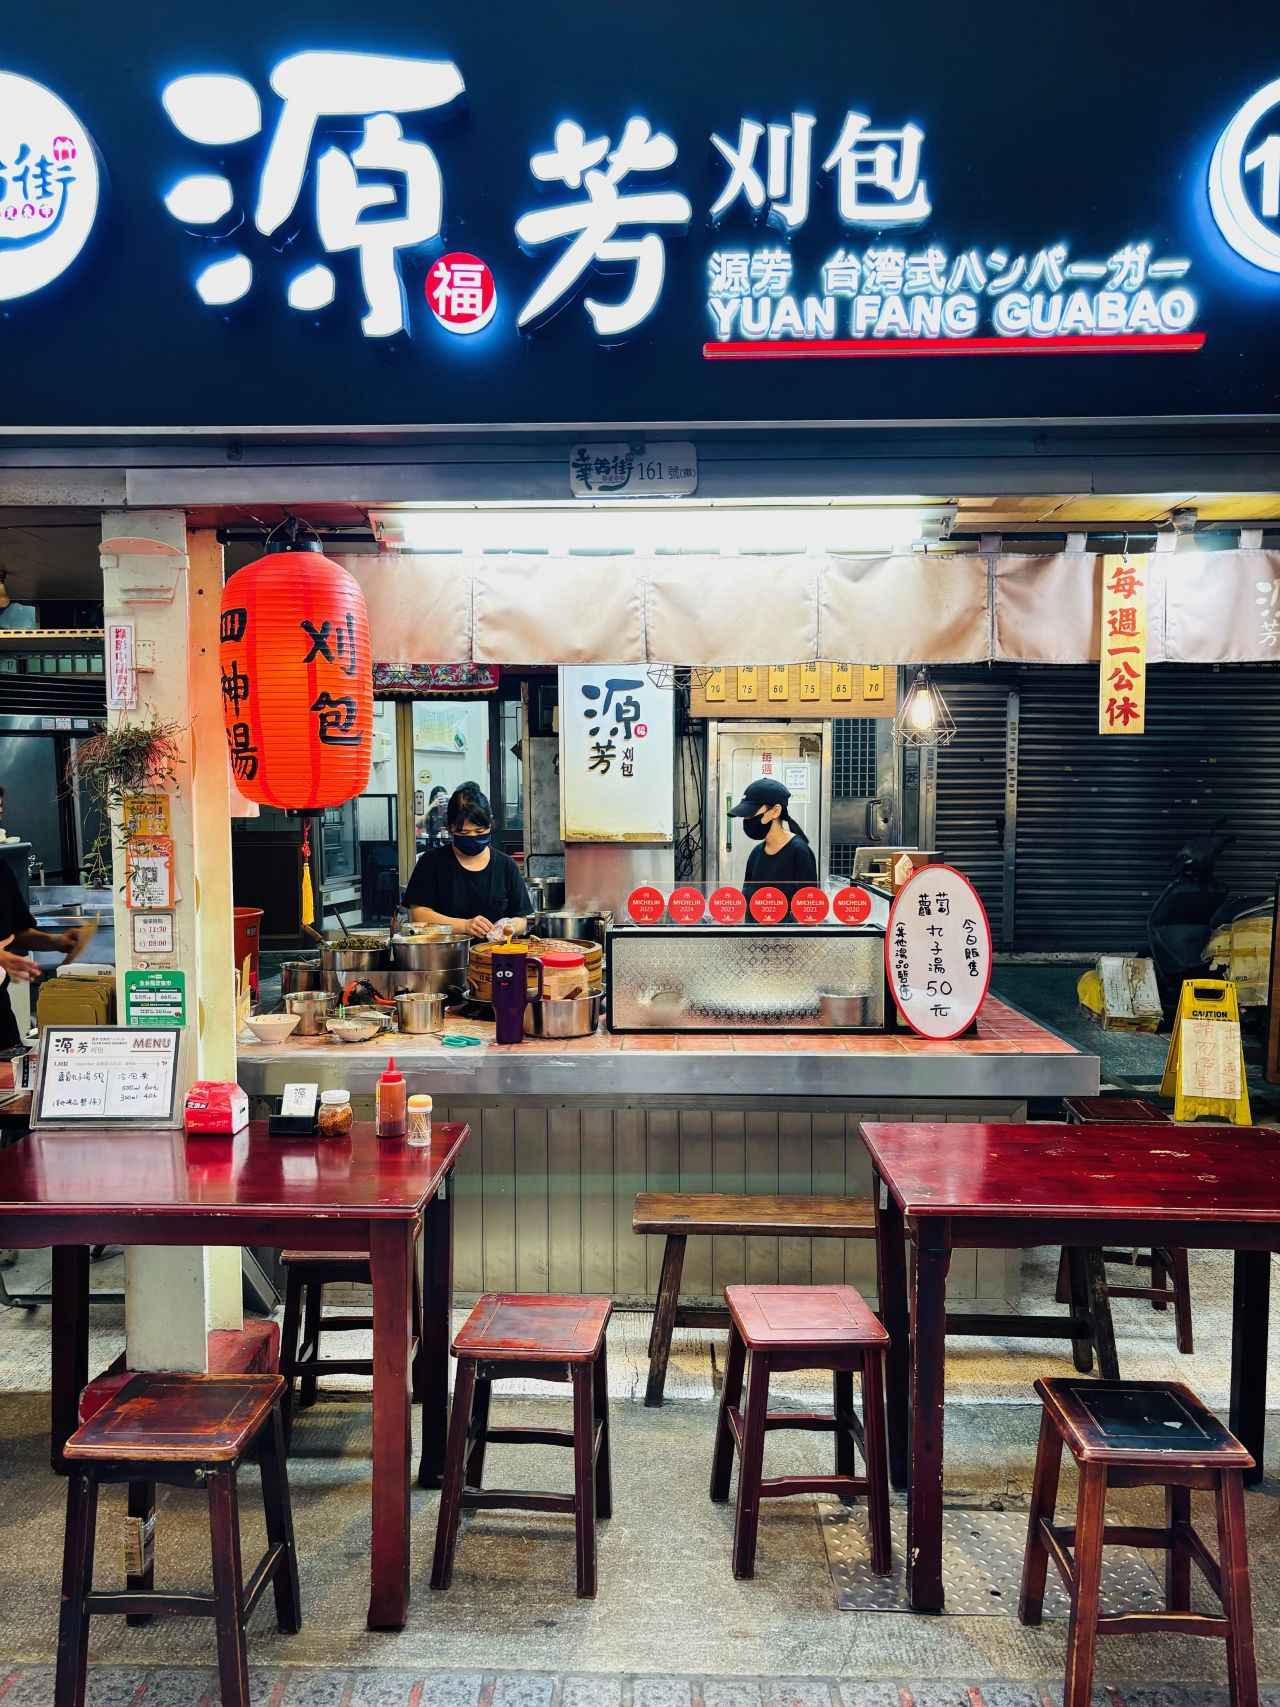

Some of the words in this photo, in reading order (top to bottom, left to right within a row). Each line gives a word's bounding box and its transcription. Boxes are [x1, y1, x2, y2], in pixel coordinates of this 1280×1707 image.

[708, 110, 932, 227] 刈包
[432, 261, 485, 316] 福
[709, 249, 792, 294] 源芳
[709, 296, 835, 340] YUAN
[853, 296, 978, 337] FANG
[994, 290, 1198, 336] GUABAO
[638, 462, 664, 480] 161
[1106, 567, 1144, 726] 每週一公休
[300, 613, 367, 745] 刈包
[581, 678, 645, 774] 源芳
[620, 746, 634, 777] 刈包
[962, 919, 980, 977] 今日販售
[1192, 1010, 1228, 1018] CAUTION
[132, 1037, 171, 1049] MENU
